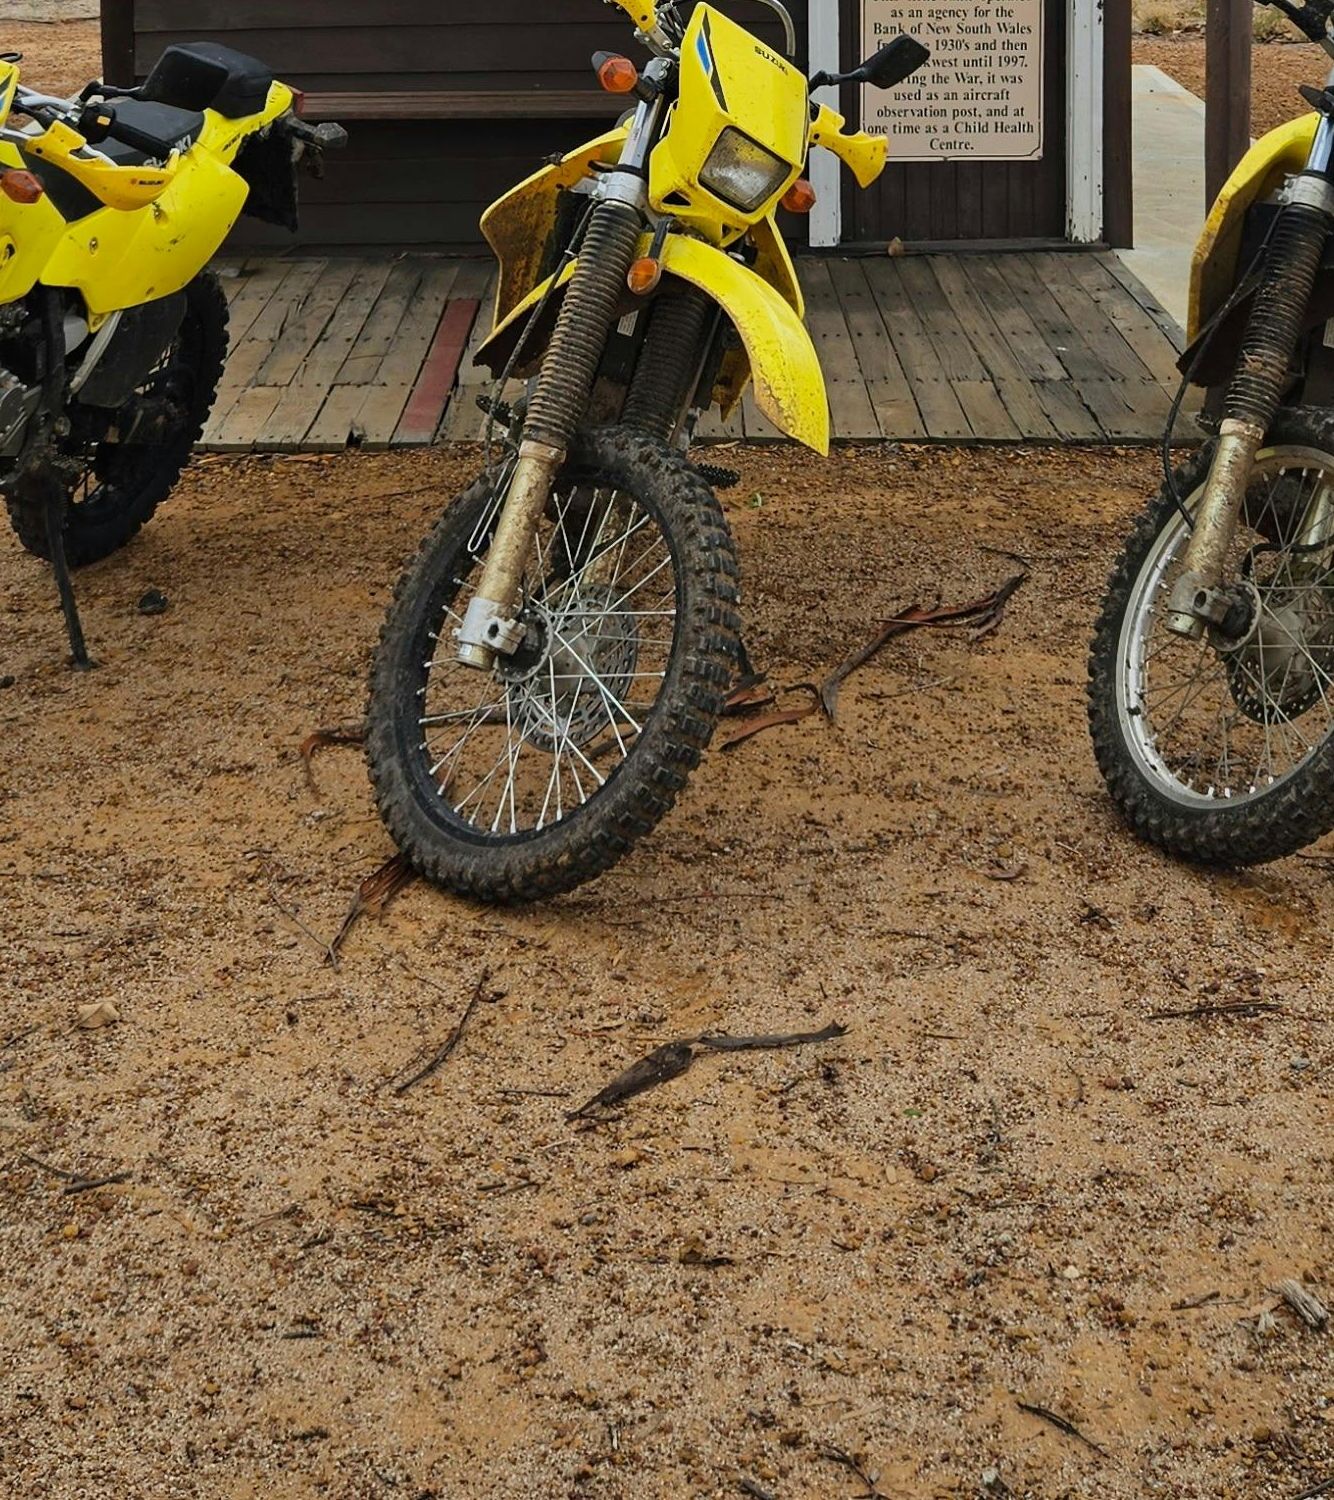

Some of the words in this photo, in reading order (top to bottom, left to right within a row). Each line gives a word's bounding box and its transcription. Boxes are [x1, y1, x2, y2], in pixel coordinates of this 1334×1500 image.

[890, 8, 904, 18] as
[908, 8, 923, 18] an
[927, 8, 969, 21] agency
[973, 6, 991, 18] for
[995, 6, 1014, 18] the
[873, 22, 905, 35] Bank
[910, 22, 923, 34] of
[926, 23, 952, 34] New
[956, 22, 991, 34] South
[996, 22, 1033, 34] Wales
[935, 38, 970, 51] 1930's
[974, 39, 997, 51] and
[1001, 38, 1028, 51] then
[754, 45, 788, 76] SUZUKI
[963, 56, 992, 67] until
[998, 55, 1028, 67] 1997.
[931, 72, 950, 84] the
[955, 72, 983, 85] War,
[987, 72, 996, 84] it
[1000, 74, 1023, 84] was
[894, 89, 922, 101] used
[926, 92, 939, 101] as
[943, 91, 958, 101] an
[963, 88, 1010, 101] aircraft
[876, 105, 947, 118] observation
[952, 107, 982, 119] post,
[986, 105, 1008, 117] and
[1013, 106, 1025, 117] at
[867, 125, 888, 134] one
[892, 122, 921, 134] time
[925, 124, 938, 134] as
[942, 124, 949, 133] a
[954, 122, 989, 134] Child
[994, 121, 1034, 134] Health
[929, 138, 975, 150] Centre.
